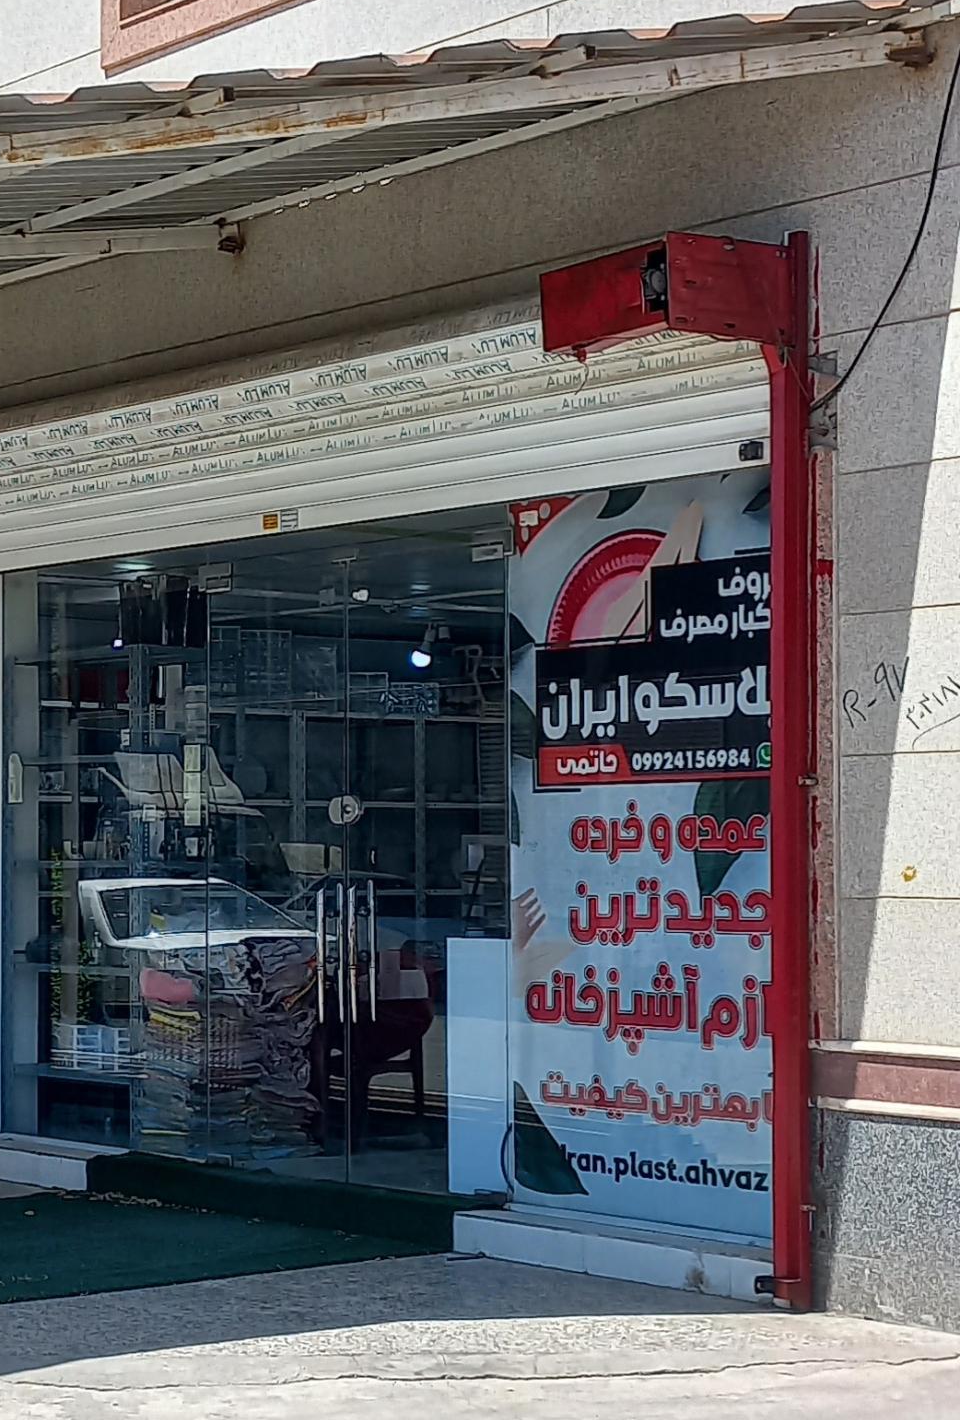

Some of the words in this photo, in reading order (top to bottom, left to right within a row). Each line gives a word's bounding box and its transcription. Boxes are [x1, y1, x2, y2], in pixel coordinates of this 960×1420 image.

[717, 566, 771, 602] روف
[660, 608, 729, 644] مصرف
[730, 602, 772, 640] کبار
[542, 674, 630, 740] ایران
[634, 665, 772, 736] لاسکو
[632, 749, 752, 772] 09924156984
[569, 799, 644, 864] خرده
[648, 813, 673, 864] و
[677, 814, 768, 853] عمده
[526, 961, 701, 1055] آشپزخانه
[701, 975, 773, 1050] ازم
[540, 1071, 650, 1120] کیفیت
[650, 1082, 760, 1132] بهترین
